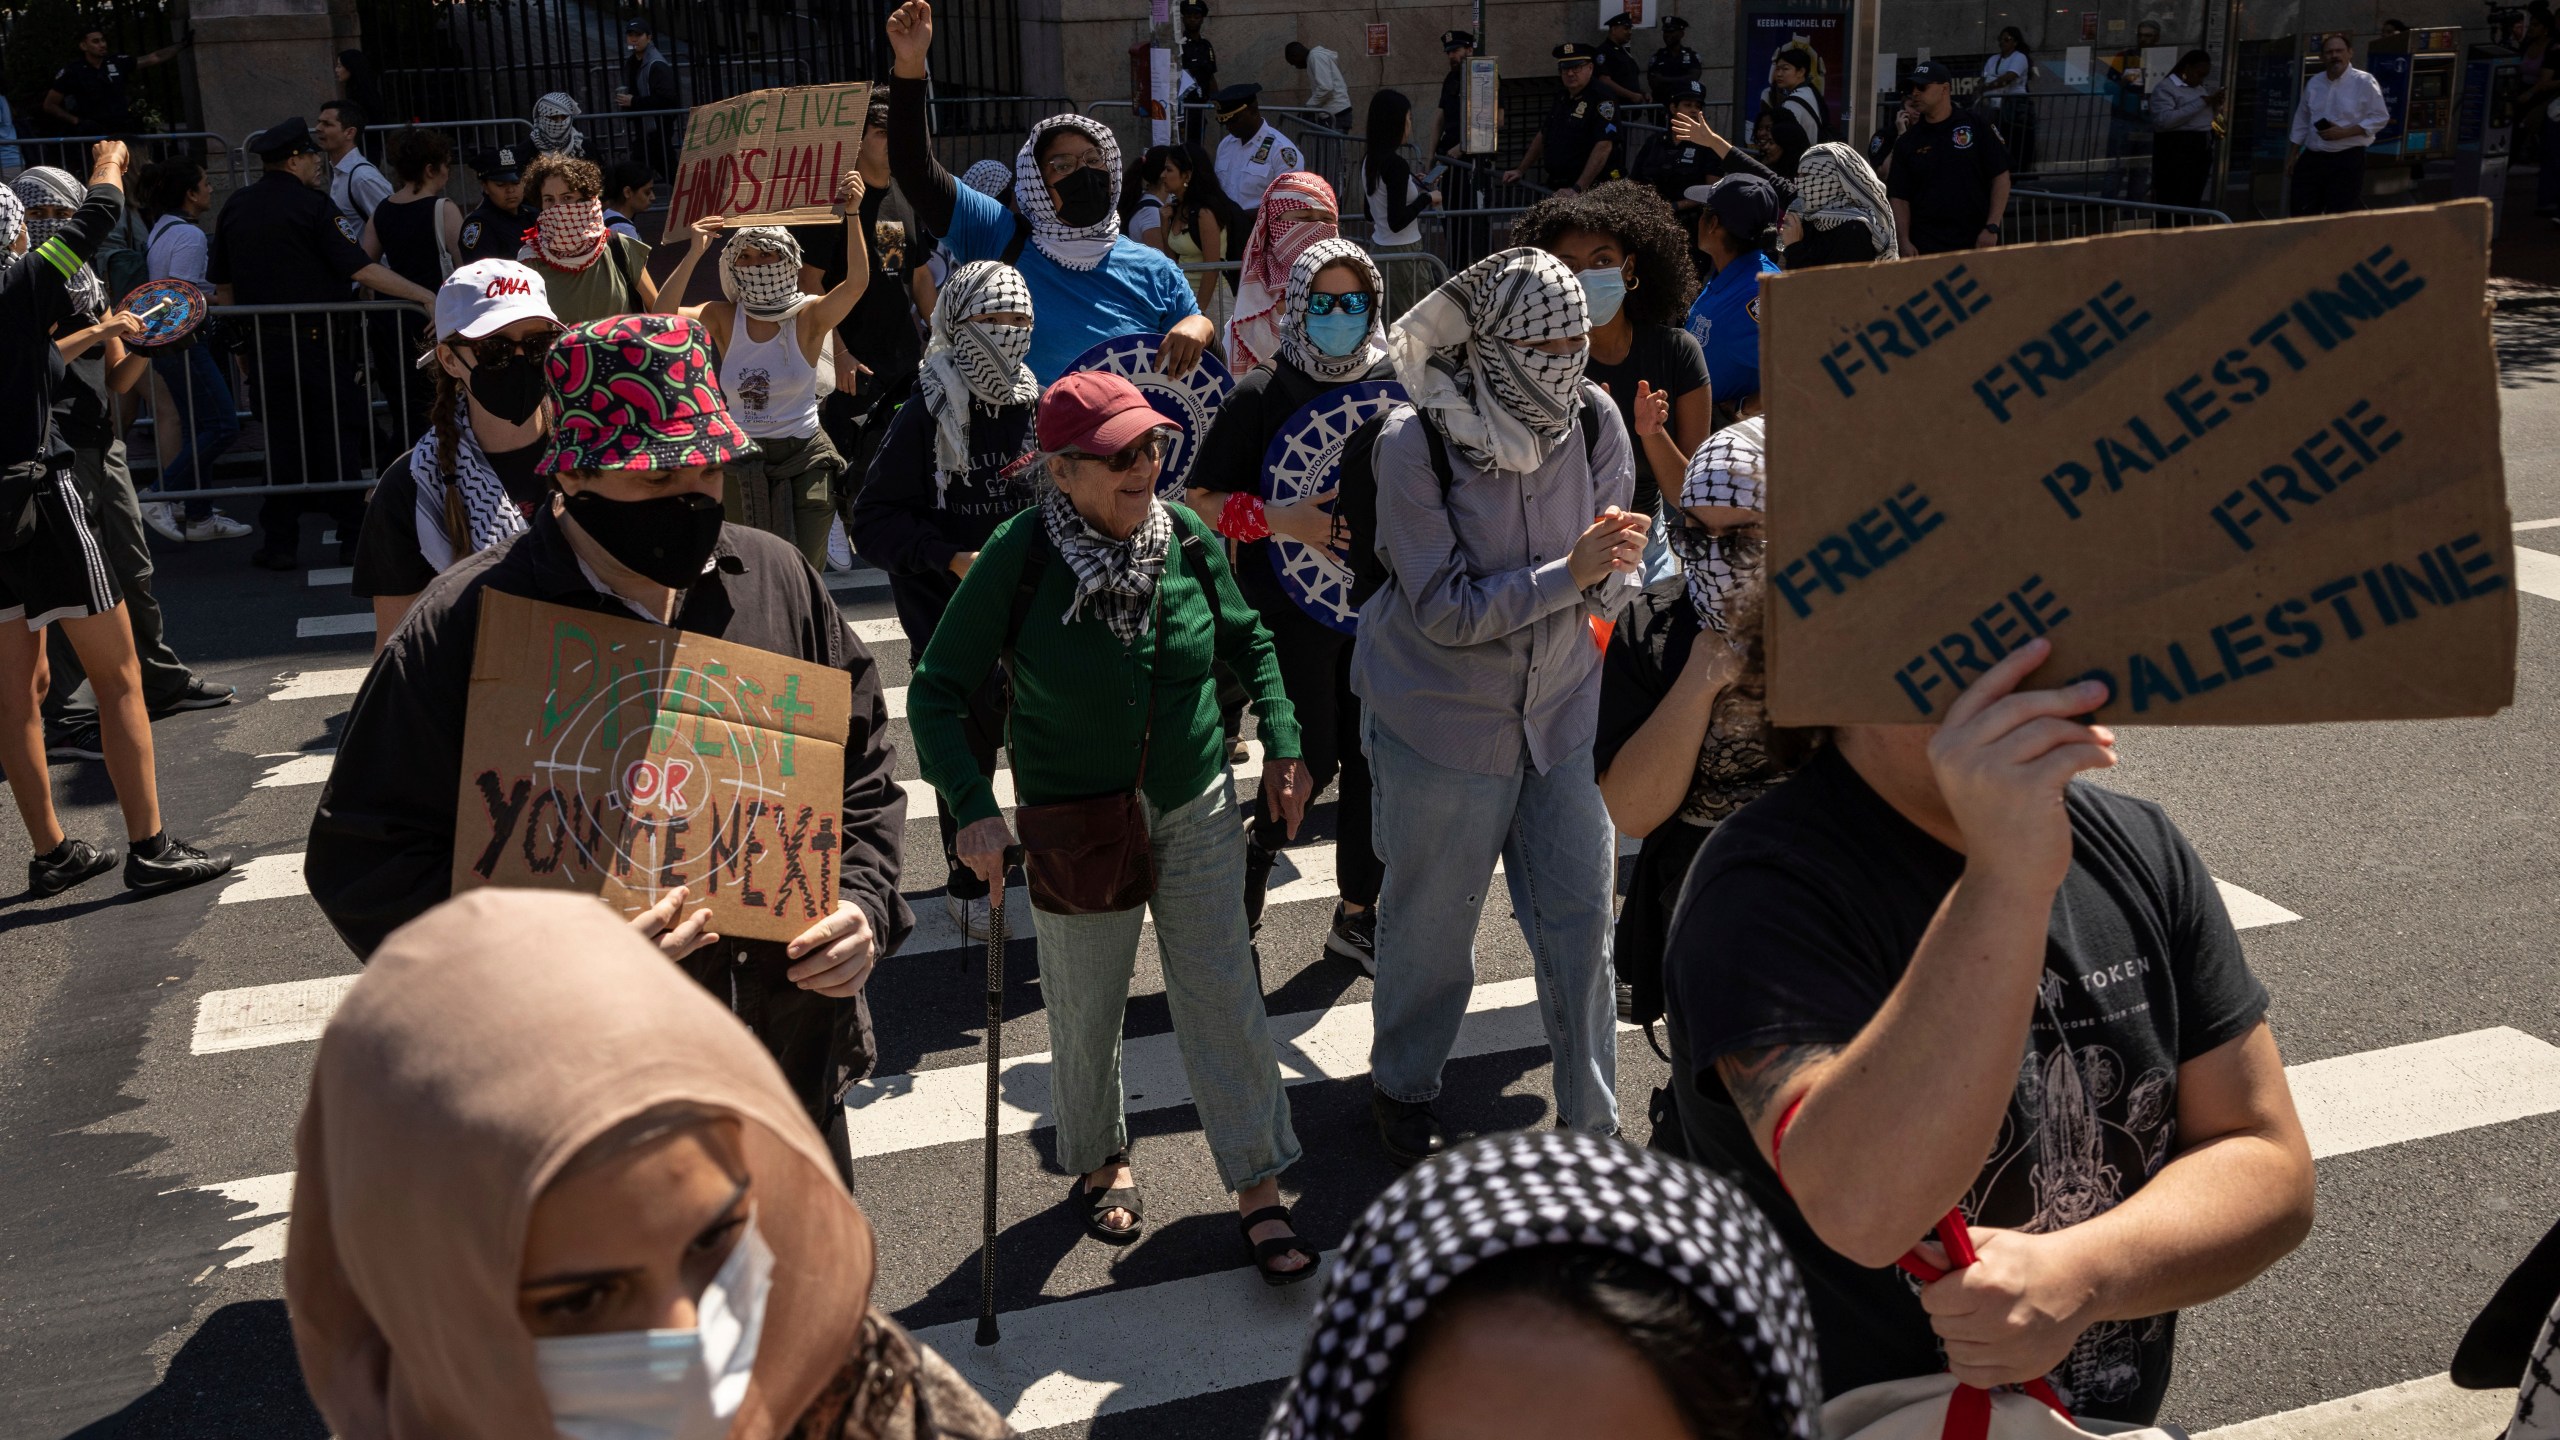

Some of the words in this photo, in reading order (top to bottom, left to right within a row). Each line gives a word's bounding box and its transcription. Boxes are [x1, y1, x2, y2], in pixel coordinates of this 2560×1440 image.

[1821, 19, 1837, 28] KEY
[688, 100, 767, 149] LONG
[776, 89, 861, 132] LIVE
[669, 148, 767, 232] HIND'S
[767, 141, 848, 209] HALL
[486, 276, 531, 298] CWA
[1821, 264, 1992, 397] FREE
[1972, 280, 2151, 423] FREE
[1188, 394, 1204, 419] UNITED
[2041, 245, 2426, 519] PALESTINE
[970, 451, 1012, 471] LUM
[2210, 399, 2403, 551] FREE
[952, 498, 1031, 516] UNIVERSIT
[1774, 482, 1946, 619] FREE
[1895, 574, 2070, 714] FREE
[624, 759, 692, 813] OR
[2080, 956, 2150, 992] TOKEN
[2063, 1018, 2095, 1030] COME
